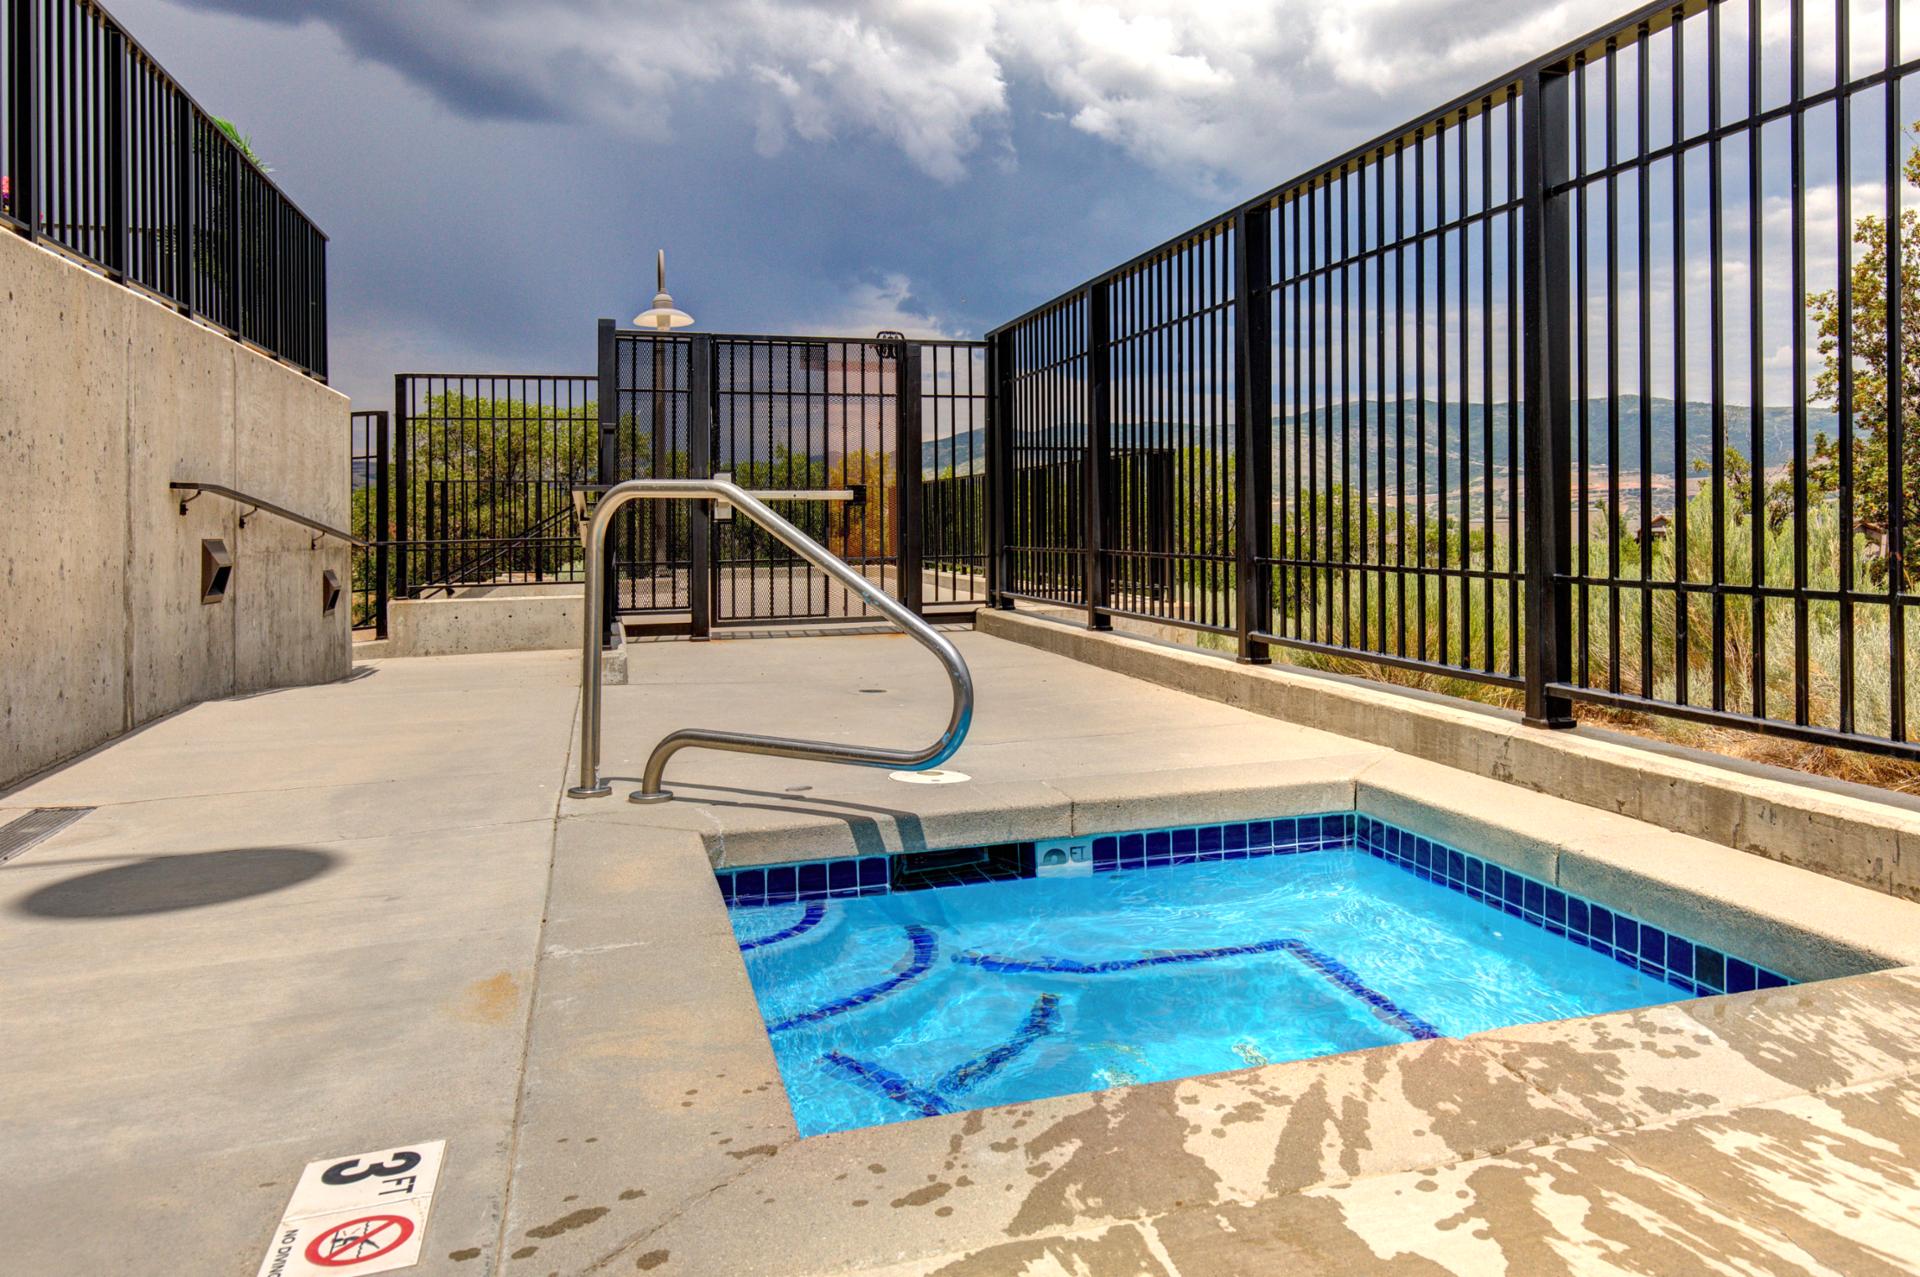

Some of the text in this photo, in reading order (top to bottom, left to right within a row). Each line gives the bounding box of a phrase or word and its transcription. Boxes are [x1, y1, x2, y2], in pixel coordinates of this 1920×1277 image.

[321, 1151, 421, 1195] 3 FT
[281, 1229, 299, 1244] NO
